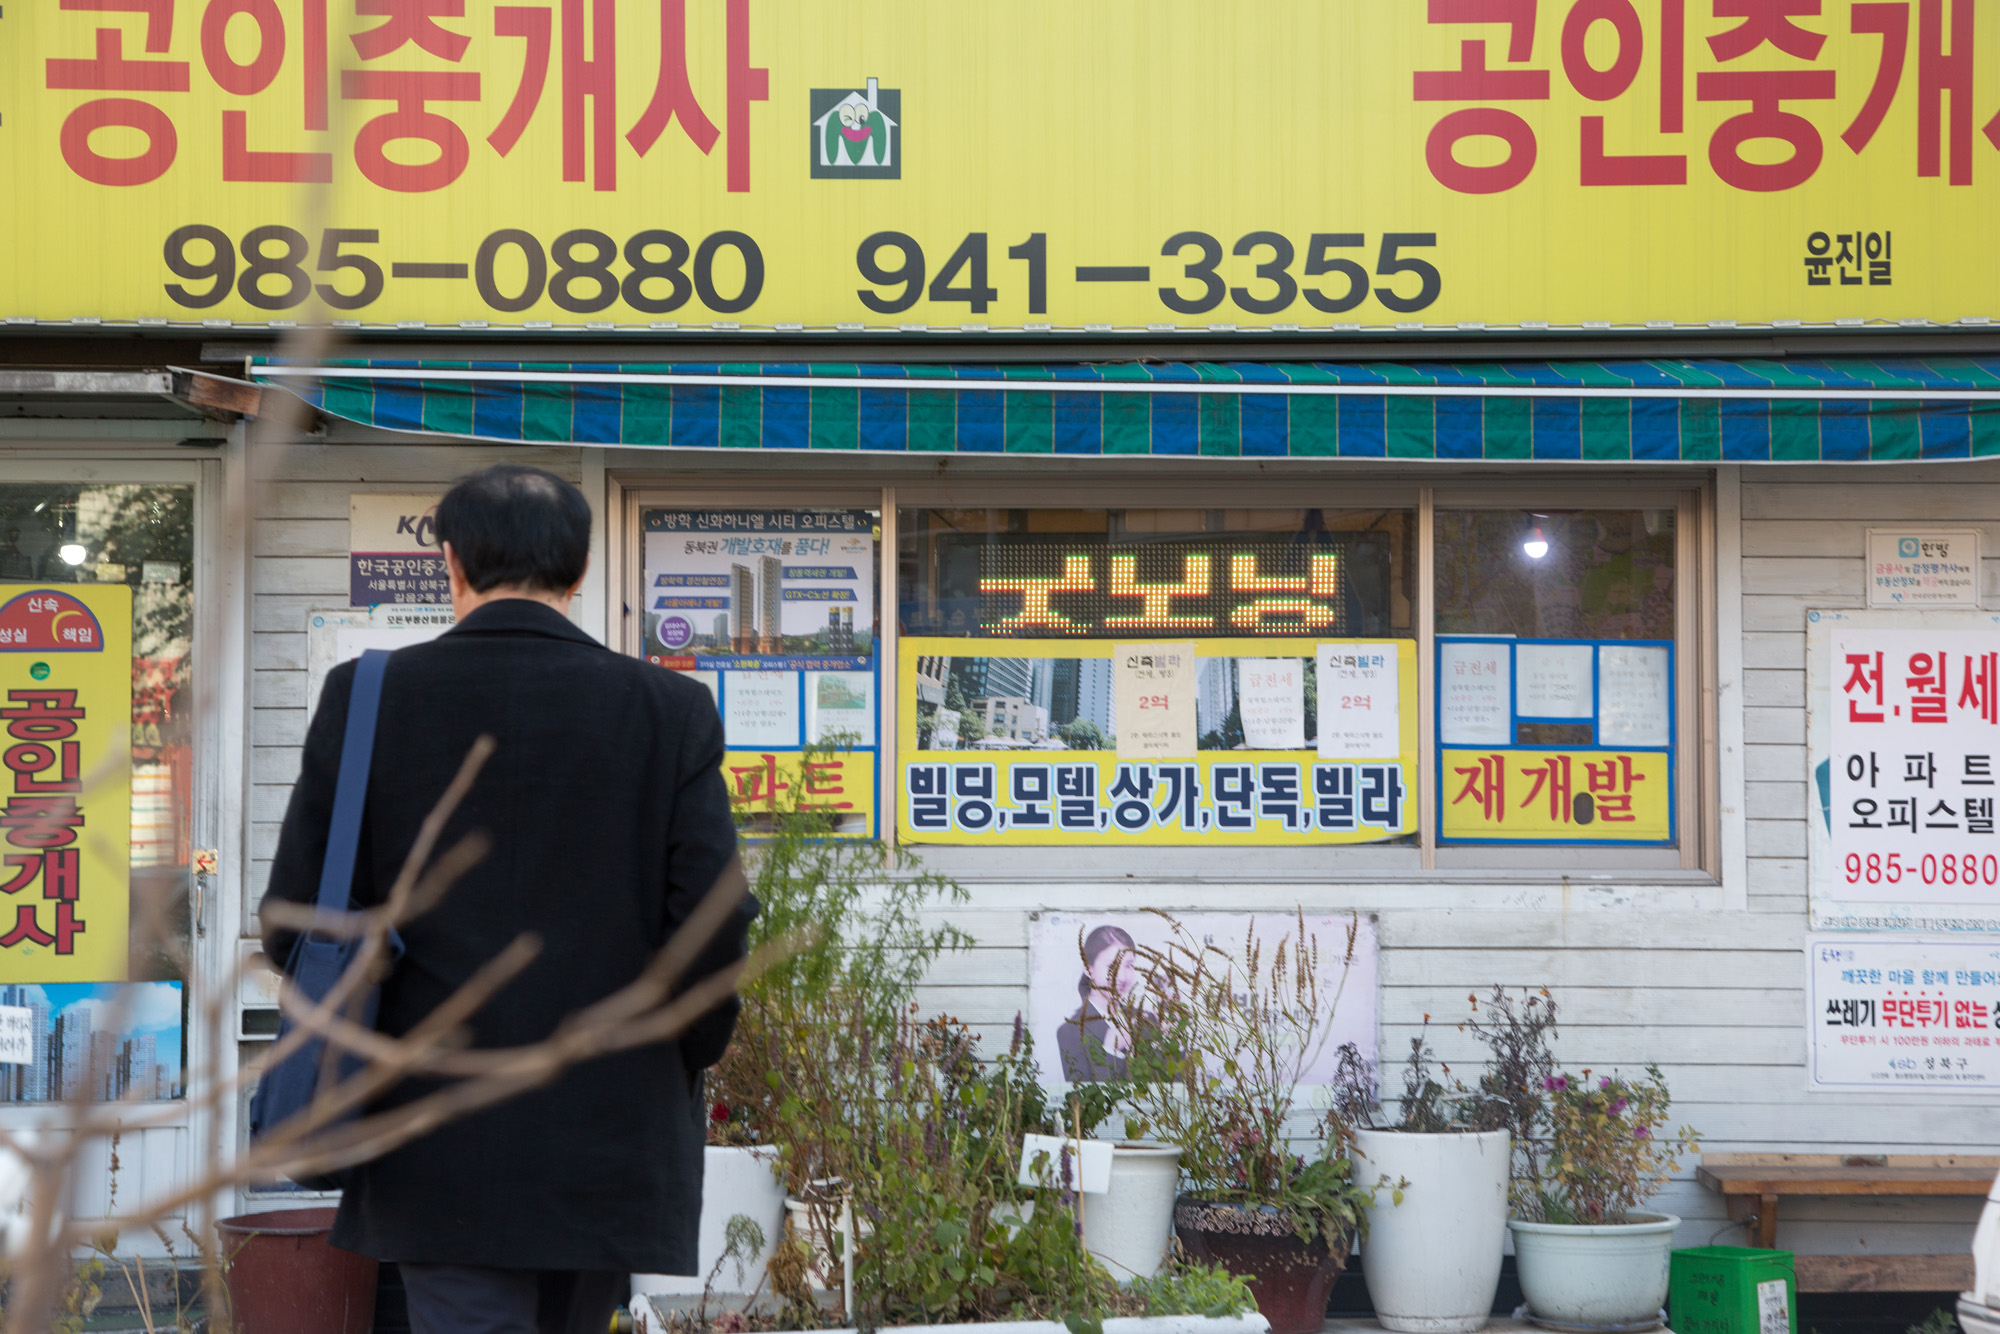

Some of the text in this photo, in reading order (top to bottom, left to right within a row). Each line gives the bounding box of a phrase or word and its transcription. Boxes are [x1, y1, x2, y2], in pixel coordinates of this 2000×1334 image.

[1413, 0, 2000, 195] 공인중개
[163, 223, 764, 313] 985-0880
[1804, 231, 1892, 285] 윤진일
[857, 230, 1442, 314] 941-3355
[664, 513, 692, 529] 방학
[768, 514, 796, 530] 시티
[800, 514, 855, 530] 오피스텔
[720, 536, 792, 556] 개발호재를
[795, 537, 831, 556] 품다!
[357, 558, 447, 577] 한국공인중
[27, 597, 59, 614] 신속
[0, 627, 93, 644] 성실 책임
[1127, 654, 1182, 669] 신축빌라
[1329, 654, 1385, 669] 신축빌라
[1139, 694, 1169, 711] 2억
[1341, 694, 1371, 711] 2억
[1452, 754, 1646, 823] 재개발
[0, 688, 86, 955] 공인중개사
[1848, 797, 1995, 834] 오피스텔
[1845, 852, 1998, 885] 985-0880
[1888, 968, 1915, 985] 마을
[1921, 969, 1949, 986] 함께
[1826, 999, 1876, 1027] 쓰레기
[1882, 999, 1949, 1028] 무단투기
[1954, 1000, 1988, 1029] 없는
